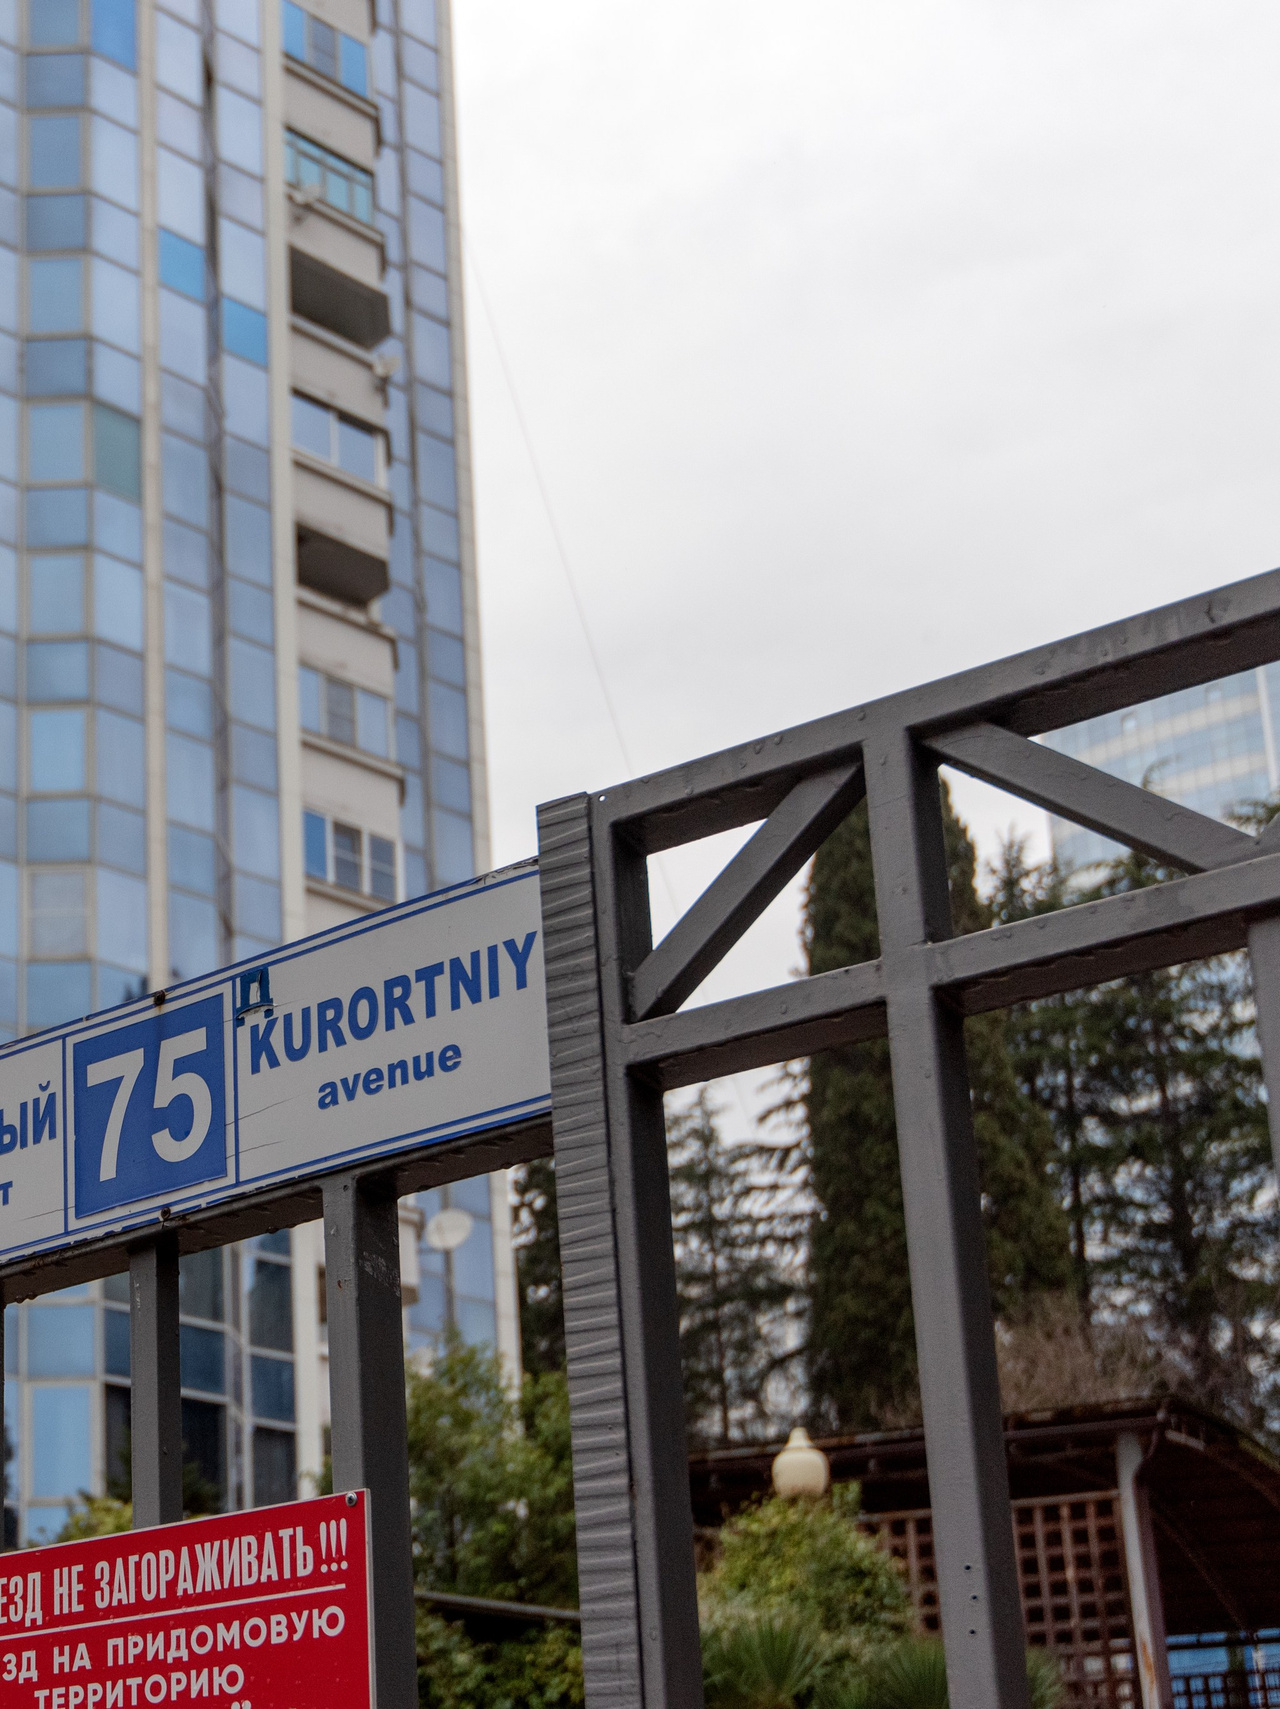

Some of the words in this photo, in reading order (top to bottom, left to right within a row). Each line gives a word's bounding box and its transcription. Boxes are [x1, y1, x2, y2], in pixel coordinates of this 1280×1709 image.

[250, 931, 537, 1075] KURORTNIY
[86, 1026, 212, 1183] 75
[317, 1043, 462, 1110] avenue
[54, 1564, 84, 1615] НЕ
[53, 1642, 92, 1674] НА
[107, 1605, 346, 1666] ПРИДОМОВУЮ
[34, 1663, 245, 1709] ТЕРРИТОРИЮ
